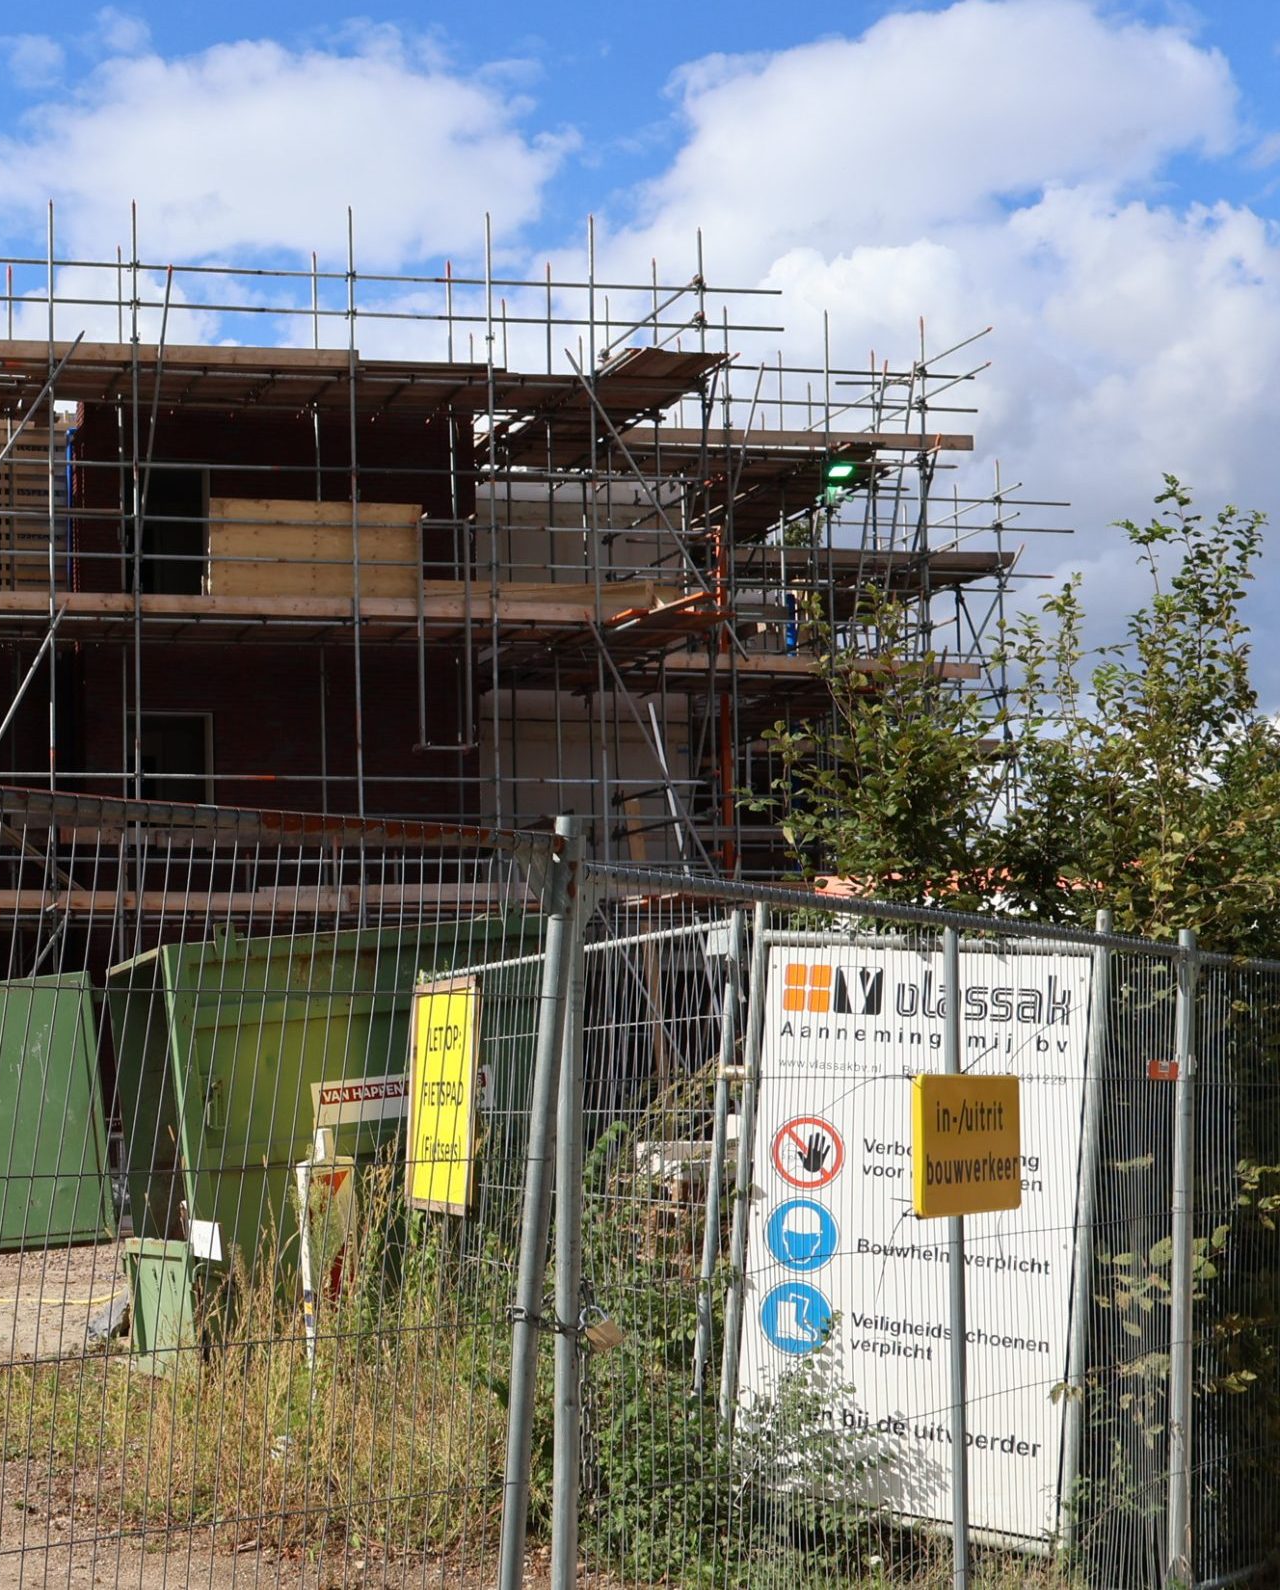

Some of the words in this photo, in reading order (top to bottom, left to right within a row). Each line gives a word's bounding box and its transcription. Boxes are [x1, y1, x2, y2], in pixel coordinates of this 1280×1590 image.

[428, 1026, 444, 1053] LET
[780, 1020, 942, 1050] Aanneming
[968, 1032, 1013, 1054] mij
[322, 1089, 350, 1103] VAN
[352, 1083, 405, 1100] HAPPEN
[422, 1081, 464, 1108] FIETSPAD
[936, 1098, 1004, 1135] in-/uitrit
[862, 1164, 905, 1179] voor
[926, 1151, 1018, 1186] bouwverkeer
[963, 1254, 1051, 1276] verplicht
[851, 1311, 1050, 1354] Veiligheidschoenen
[850, 1338, 933, 1361] verplicht
[842, 1408, 870, 1430] bij
[876, 1414, 906, 1437] de
